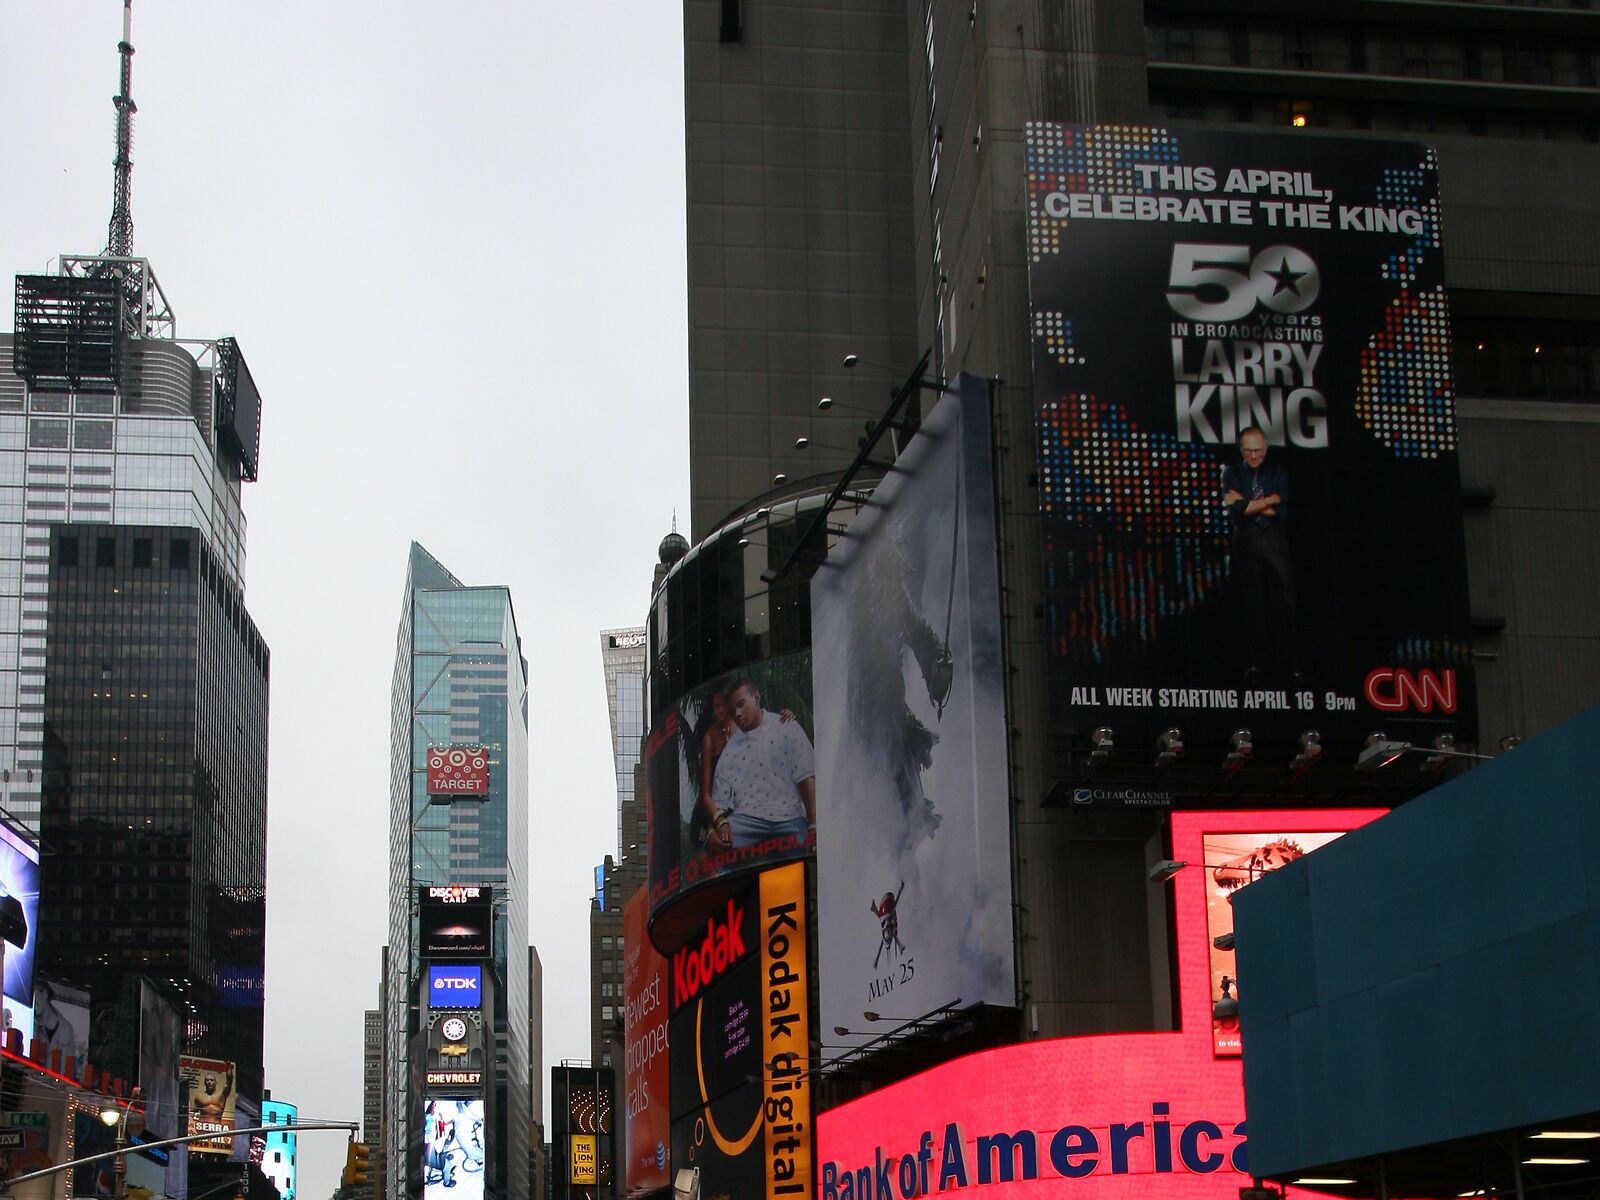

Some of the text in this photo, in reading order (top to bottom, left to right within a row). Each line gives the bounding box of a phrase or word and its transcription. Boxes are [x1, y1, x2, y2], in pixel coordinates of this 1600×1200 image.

[1134, 164, 1333, 202] THIS APRIL,
[1044, 192, 1425, 236] CELEBRATE THE KING
[1166, 242, 1320, 320] 50
[1171, 322, 1324, 343] IN BROADCASTING
[1259, 312, 1322, 327] years
[1170, 337, 1325, 388] LARRY
[1174, 383, 1330, 449] KING
[1070, 686, 1356, 712] ALL WEEK STARTING APRIL 16 9PM
[1363, 665, 1458, 715] CNN
[433, 779, 482, 790] TARGET
[429, 887, 481, 898] DISCOVER
[442, 896, 468, 904] CARD
[673, 897, 746, 1009] Kodak
[444, 977, 477, 989] TDK
[868, 957, 915, 1003] MAY 25
[624, 971, 661, 1035] fewest
[767, 902, 805, 1196] Kodak digital
[427, 1072, 481, 1085] CHEVROLET
[627, 1074, 649, 1120] calls
[196, 1122, 230, 1132] SERRA
[573, 1153, 593, 1165] LION
[576, 1143, 591, 1151] THE
[573, 1166, 594, 1178] KING
[899, 1131, 935, 1200] of
